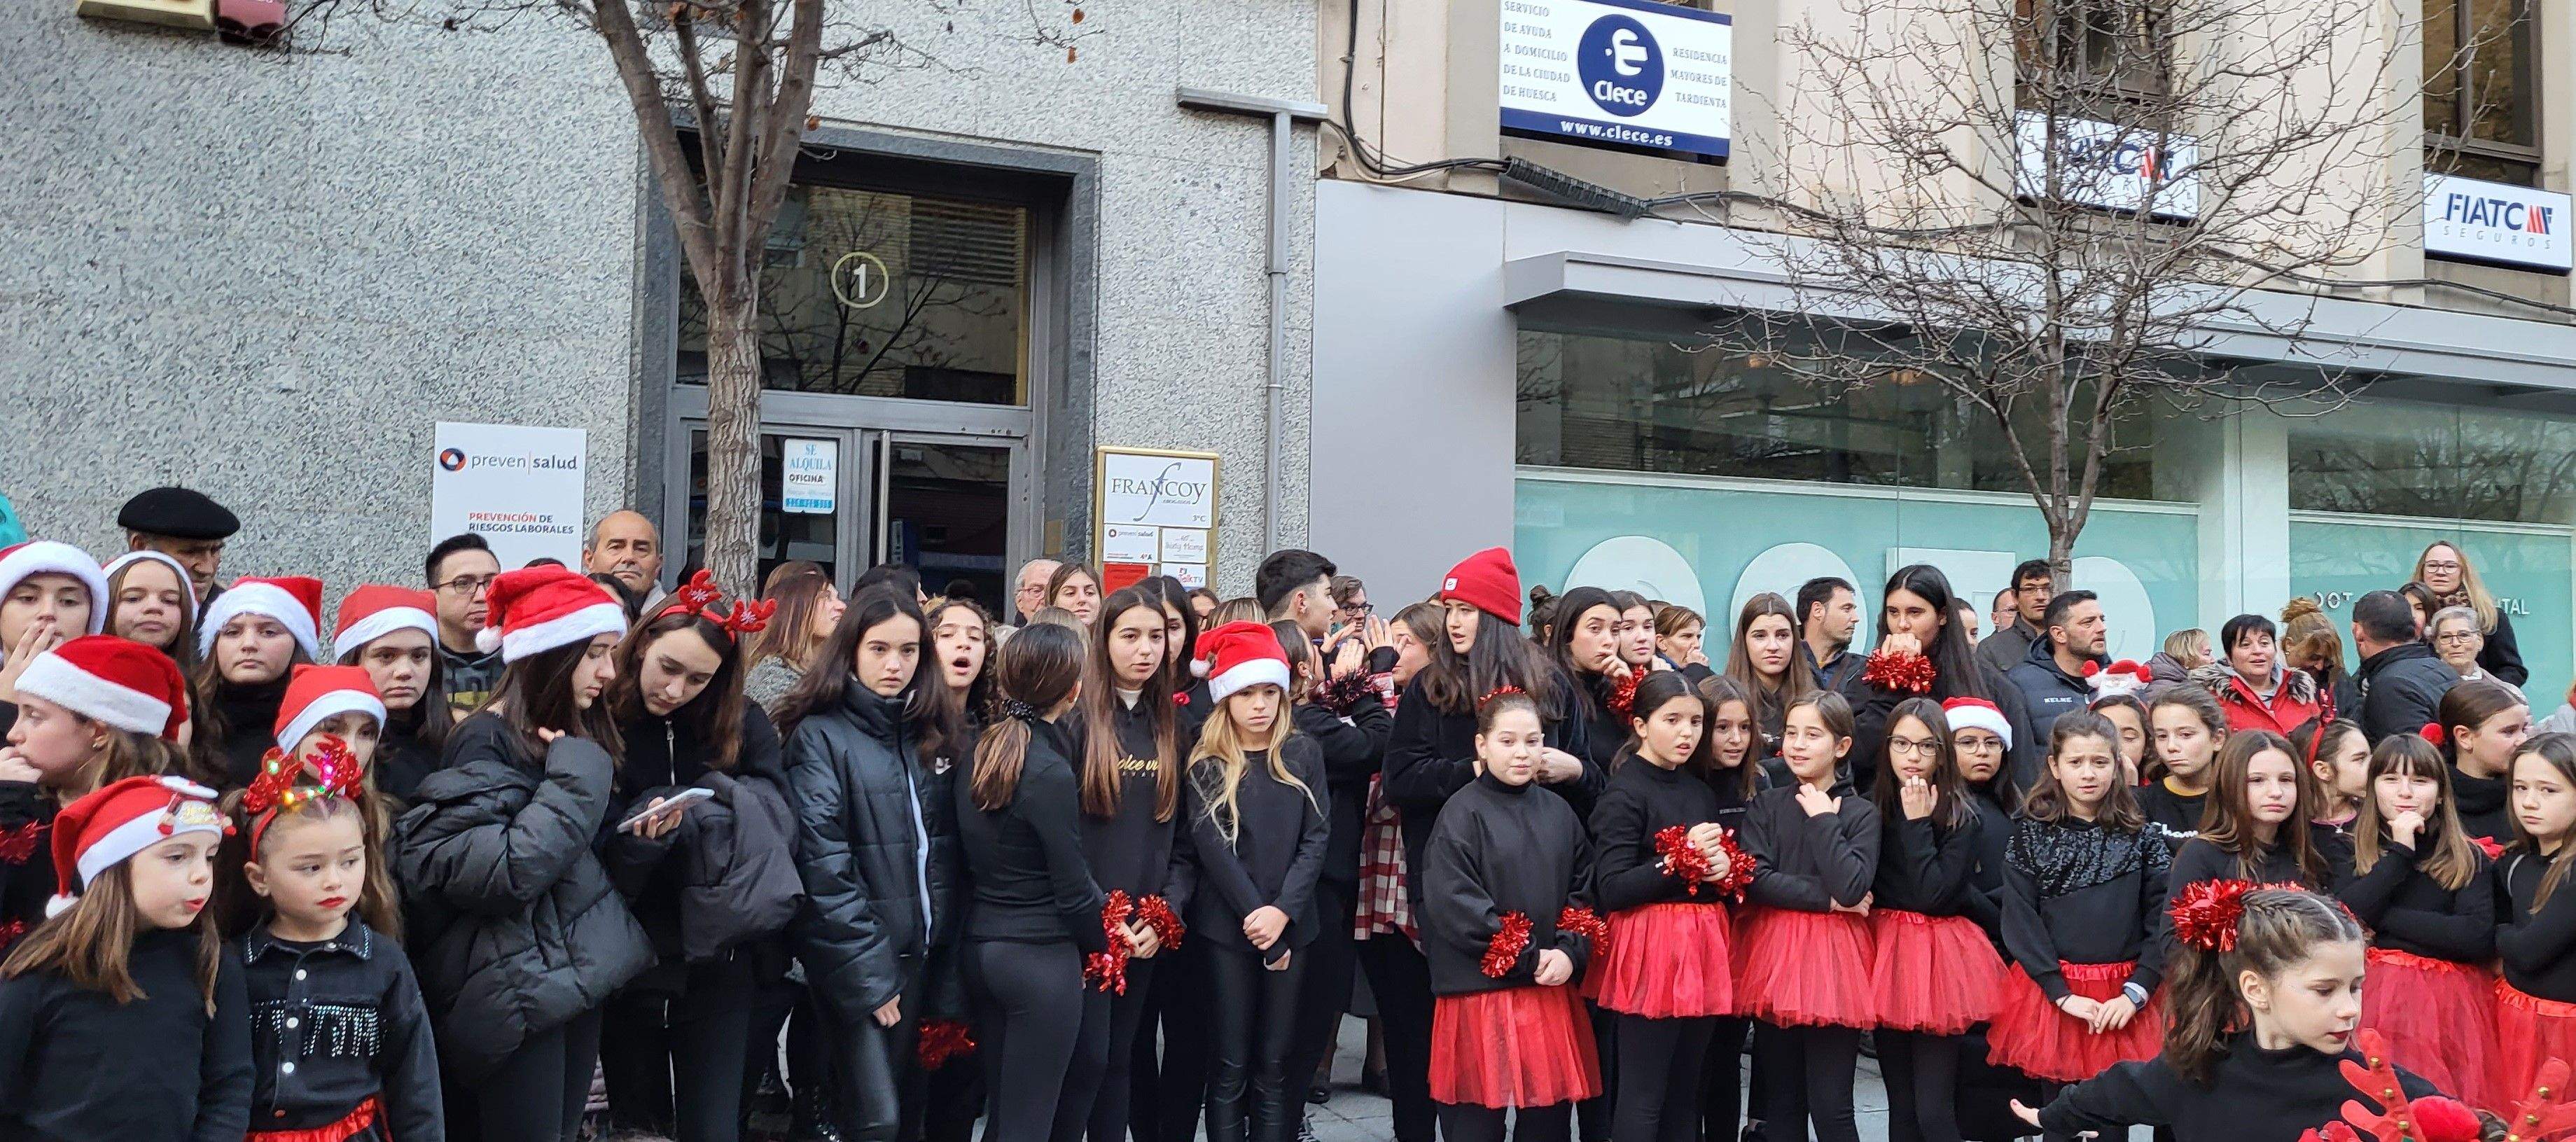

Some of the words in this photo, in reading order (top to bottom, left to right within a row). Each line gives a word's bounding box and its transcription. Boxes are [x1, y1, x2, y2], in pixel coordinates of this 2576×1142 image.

[1504, 1, 1550, 17] SERVICIO
[1504, 22, 1517, 33] DE
[1519, 25, 1552, 39] AYUDA
[1503, 43, 1511, 53] A
[1515, 44, 1568, 62] DOMICILIO
[1673, 47, 1727, 64] RESIDENCIA
[1503, 64, 1517, 75] DE
[1519, 66, 1531, 77] LA
[1533, 68, 1571, 83] CIUDAD
[1671, 69, 1713, 84] MAYORES
[1715, 76, 1727, 87] DE
[1503, 85, 1517, 96] DE
[1518, 87, 1557, 102] HUESCA
[1594, 80, 1648, 106] Clece
[1675, 92, 1727, 108] TARDIENTA
[1560, 120, 1673, 147] www.clece.es
[2446, 193, 2524, 230] FIATC
[2443, 225, 2552, 249] SEGUROS
[853, 263, 867, 298] 1
[471, 455, 525, 469] preven
[532, 454, 578, 470] salud
[790, 457, 832, 471] ALQUILA
[789, 474, 823, 483] OFICINA
[1111, 478, 1208, 505] FRANCOY
[468, 511, 537, 522] PREVENCIÓN
[538, 515, 554, 523] DE
[468, 523, 513, 533] RIESGOS
[515, 524, 574, 534] LABORALES
